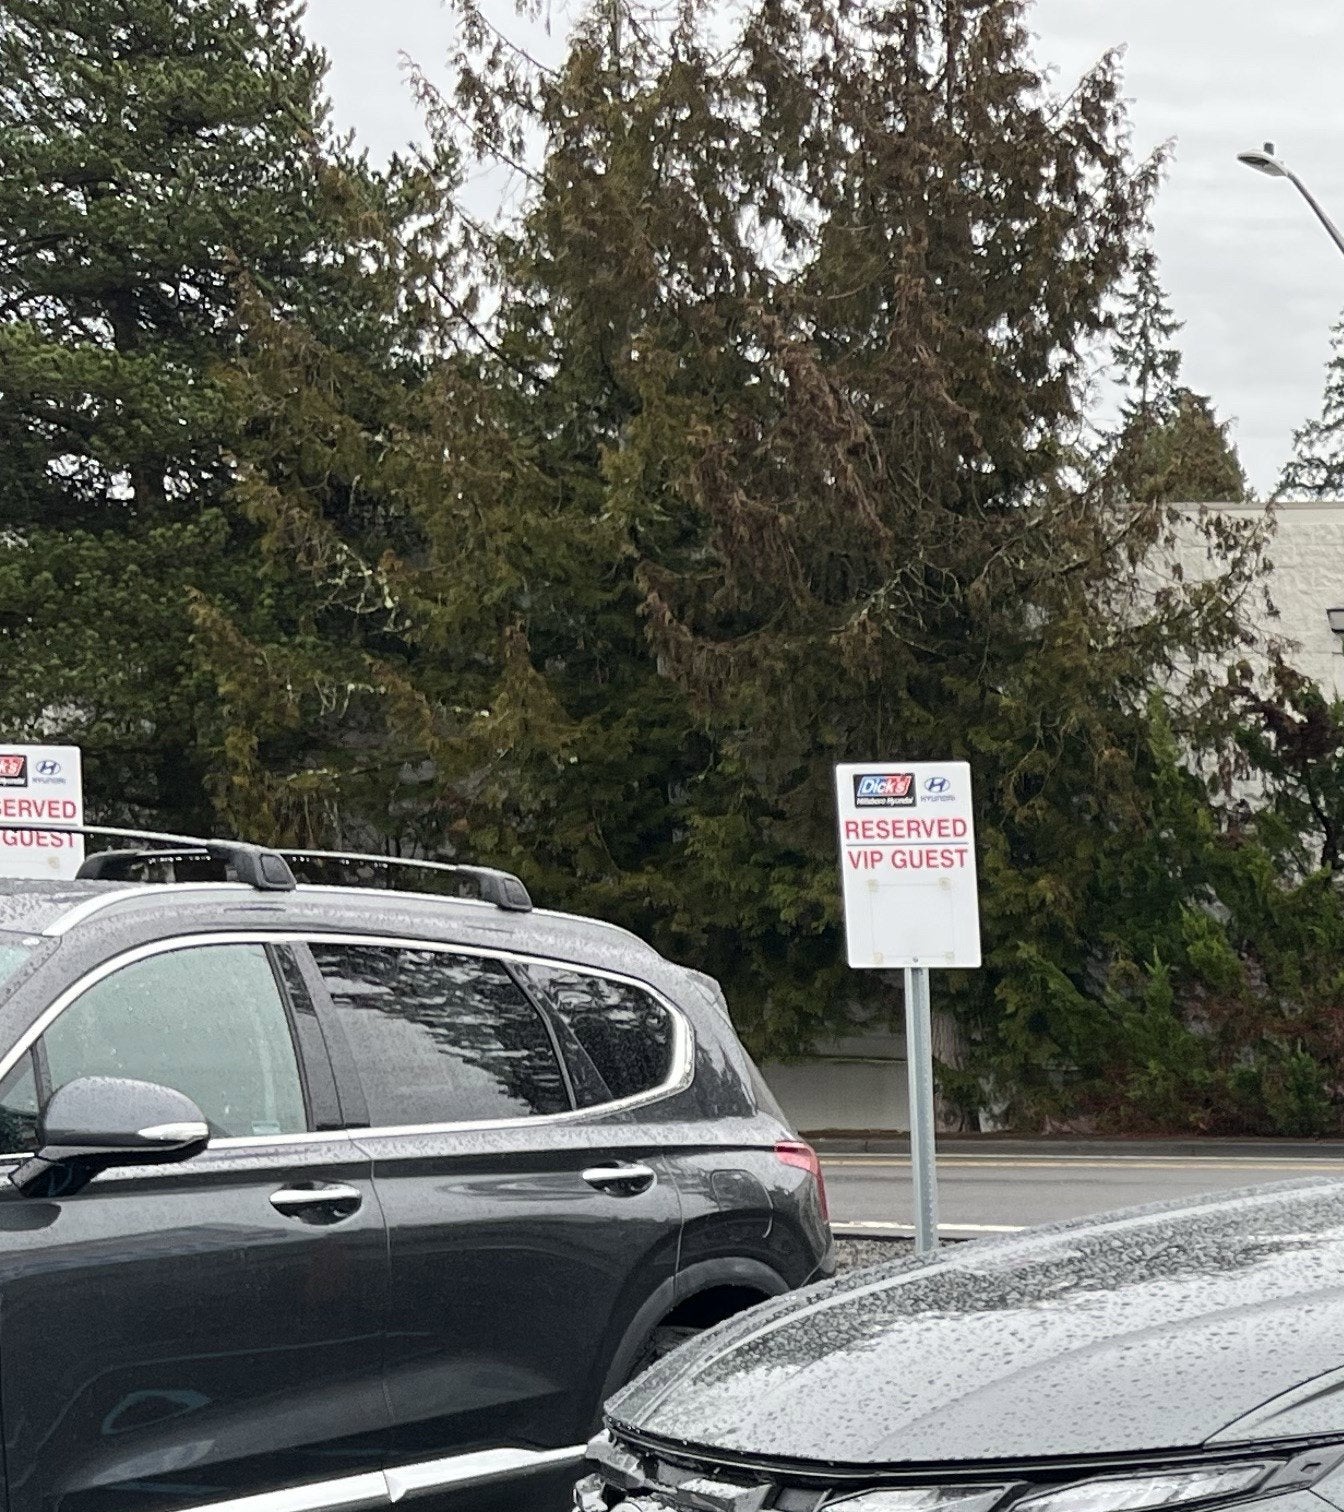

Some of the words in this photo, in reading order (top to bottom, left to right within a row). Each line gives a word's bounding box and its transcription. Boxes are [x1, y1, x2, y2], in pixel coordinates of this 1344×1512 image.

[0, 799, 77, 819] ERVED
[845, 818, 967, 839] RESERVED
[848, 850, 883, 869] VIP
[891, 849, 968, 869] GUEST
